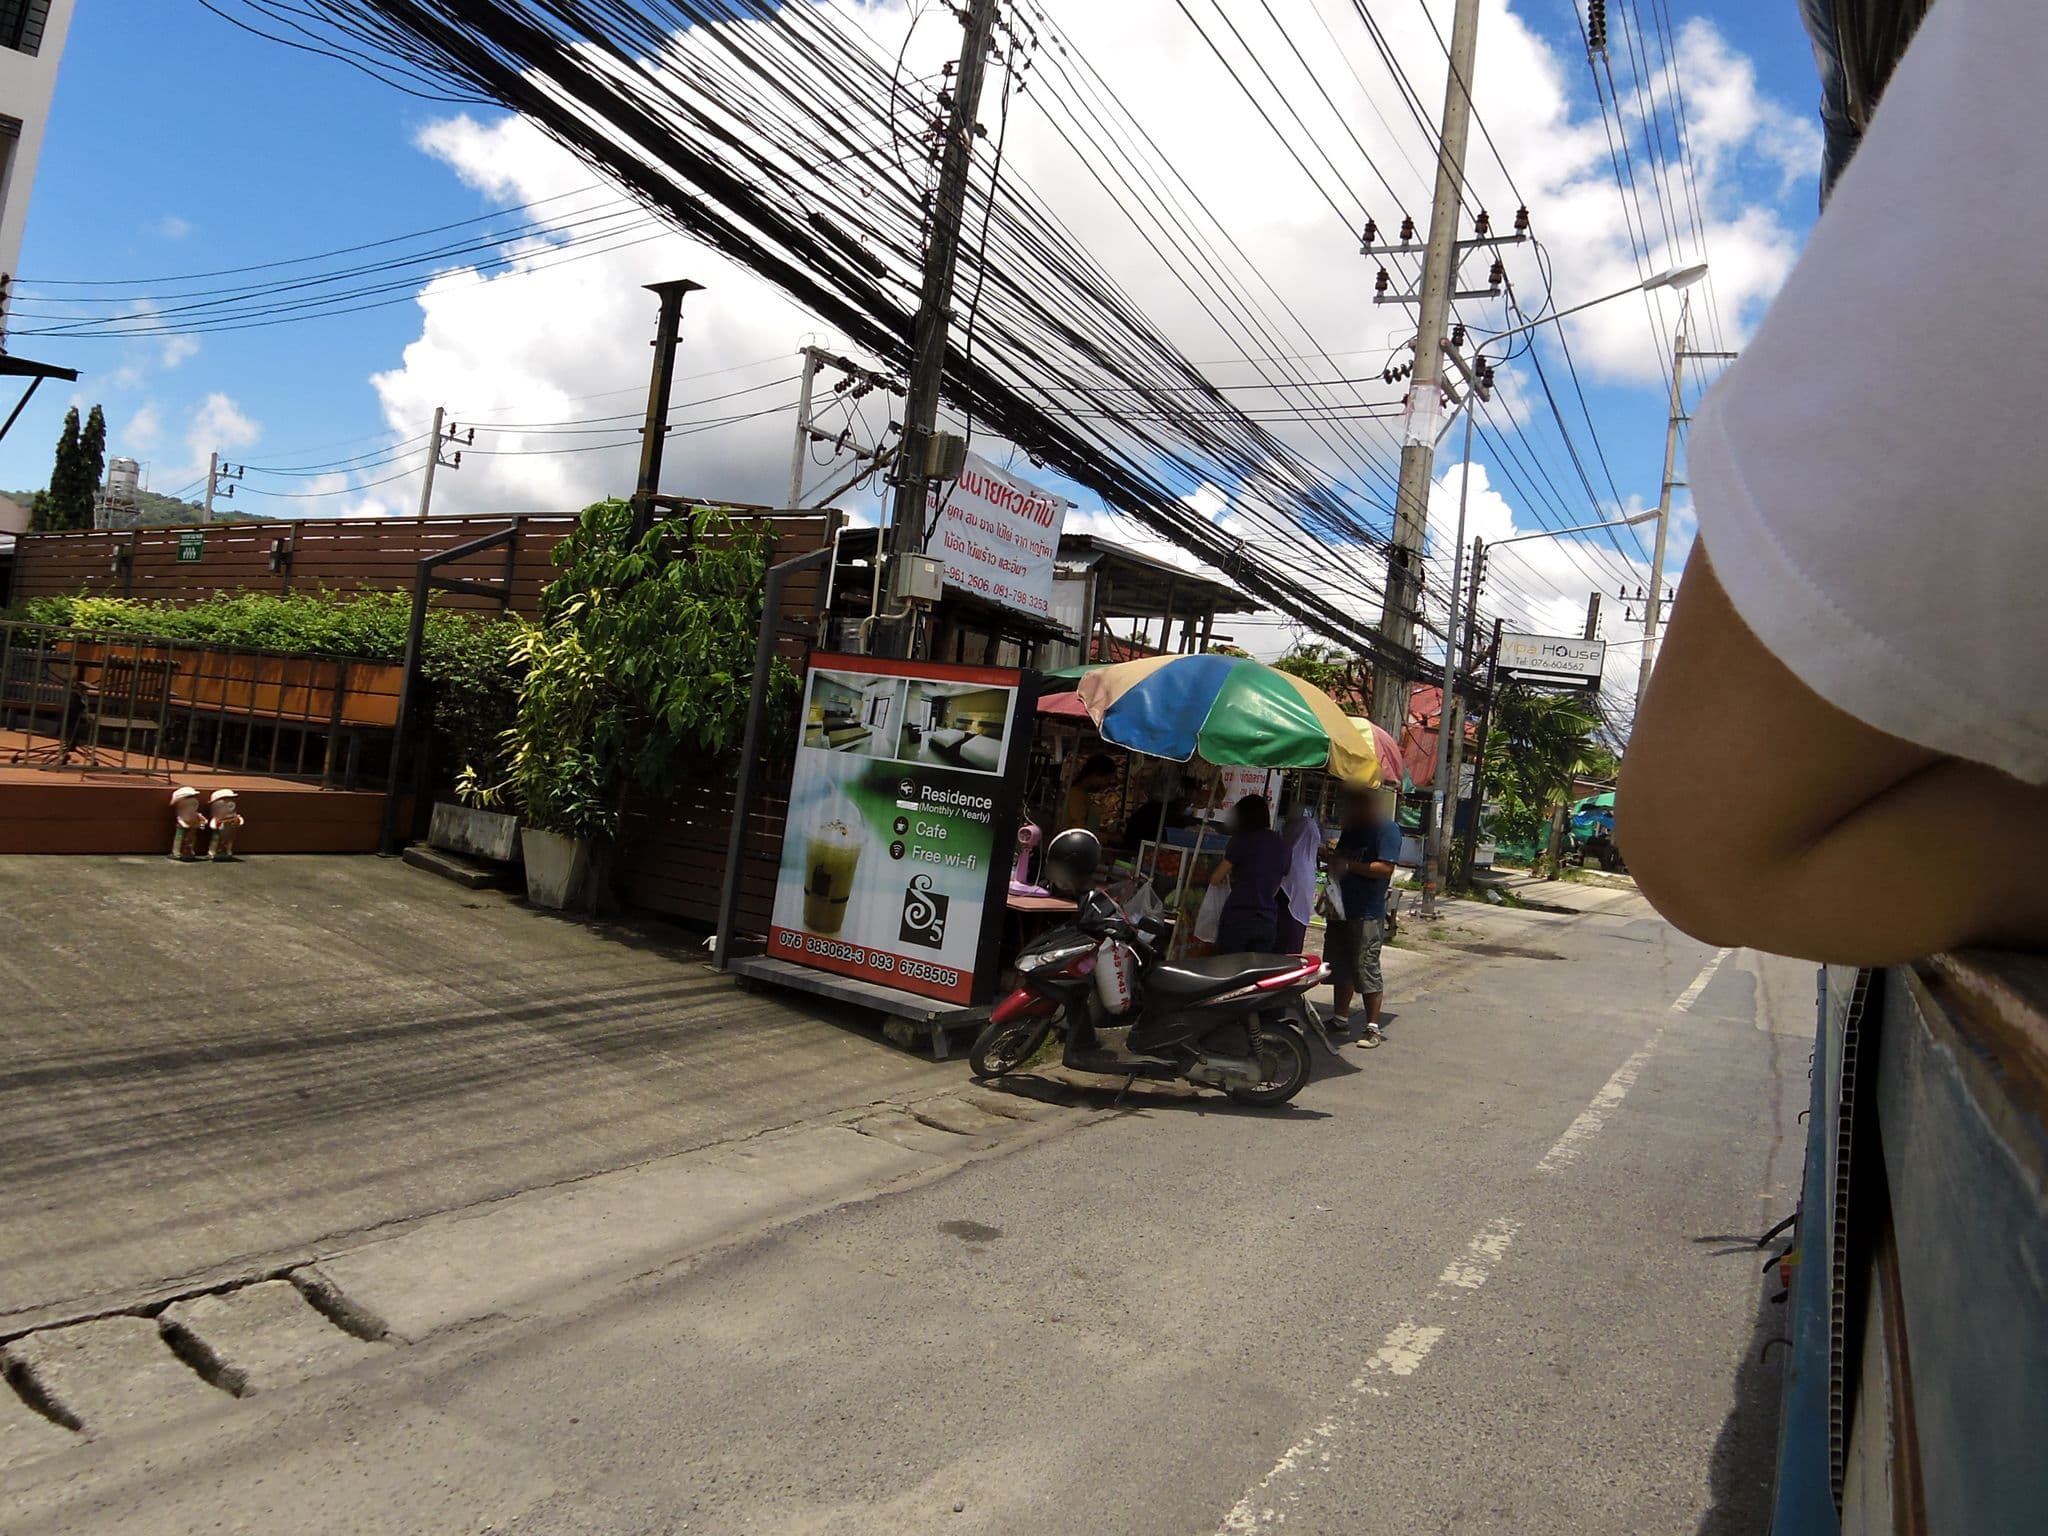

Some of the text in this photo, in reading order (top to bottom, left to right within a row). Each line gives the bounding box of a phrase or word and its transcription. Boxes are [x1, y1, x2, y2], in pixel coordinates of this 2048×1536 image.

[921, 785, 992, 809] Residence
[918, 801, 955, 819] (Monthly
[961, 807, 991, 824] Yearly)
[916, 822, 948, 840] Cafe
[911, 845, 977, 872] Free wi-fi
[780, 931, 958, 987] 076 383062-3 093 6758505
